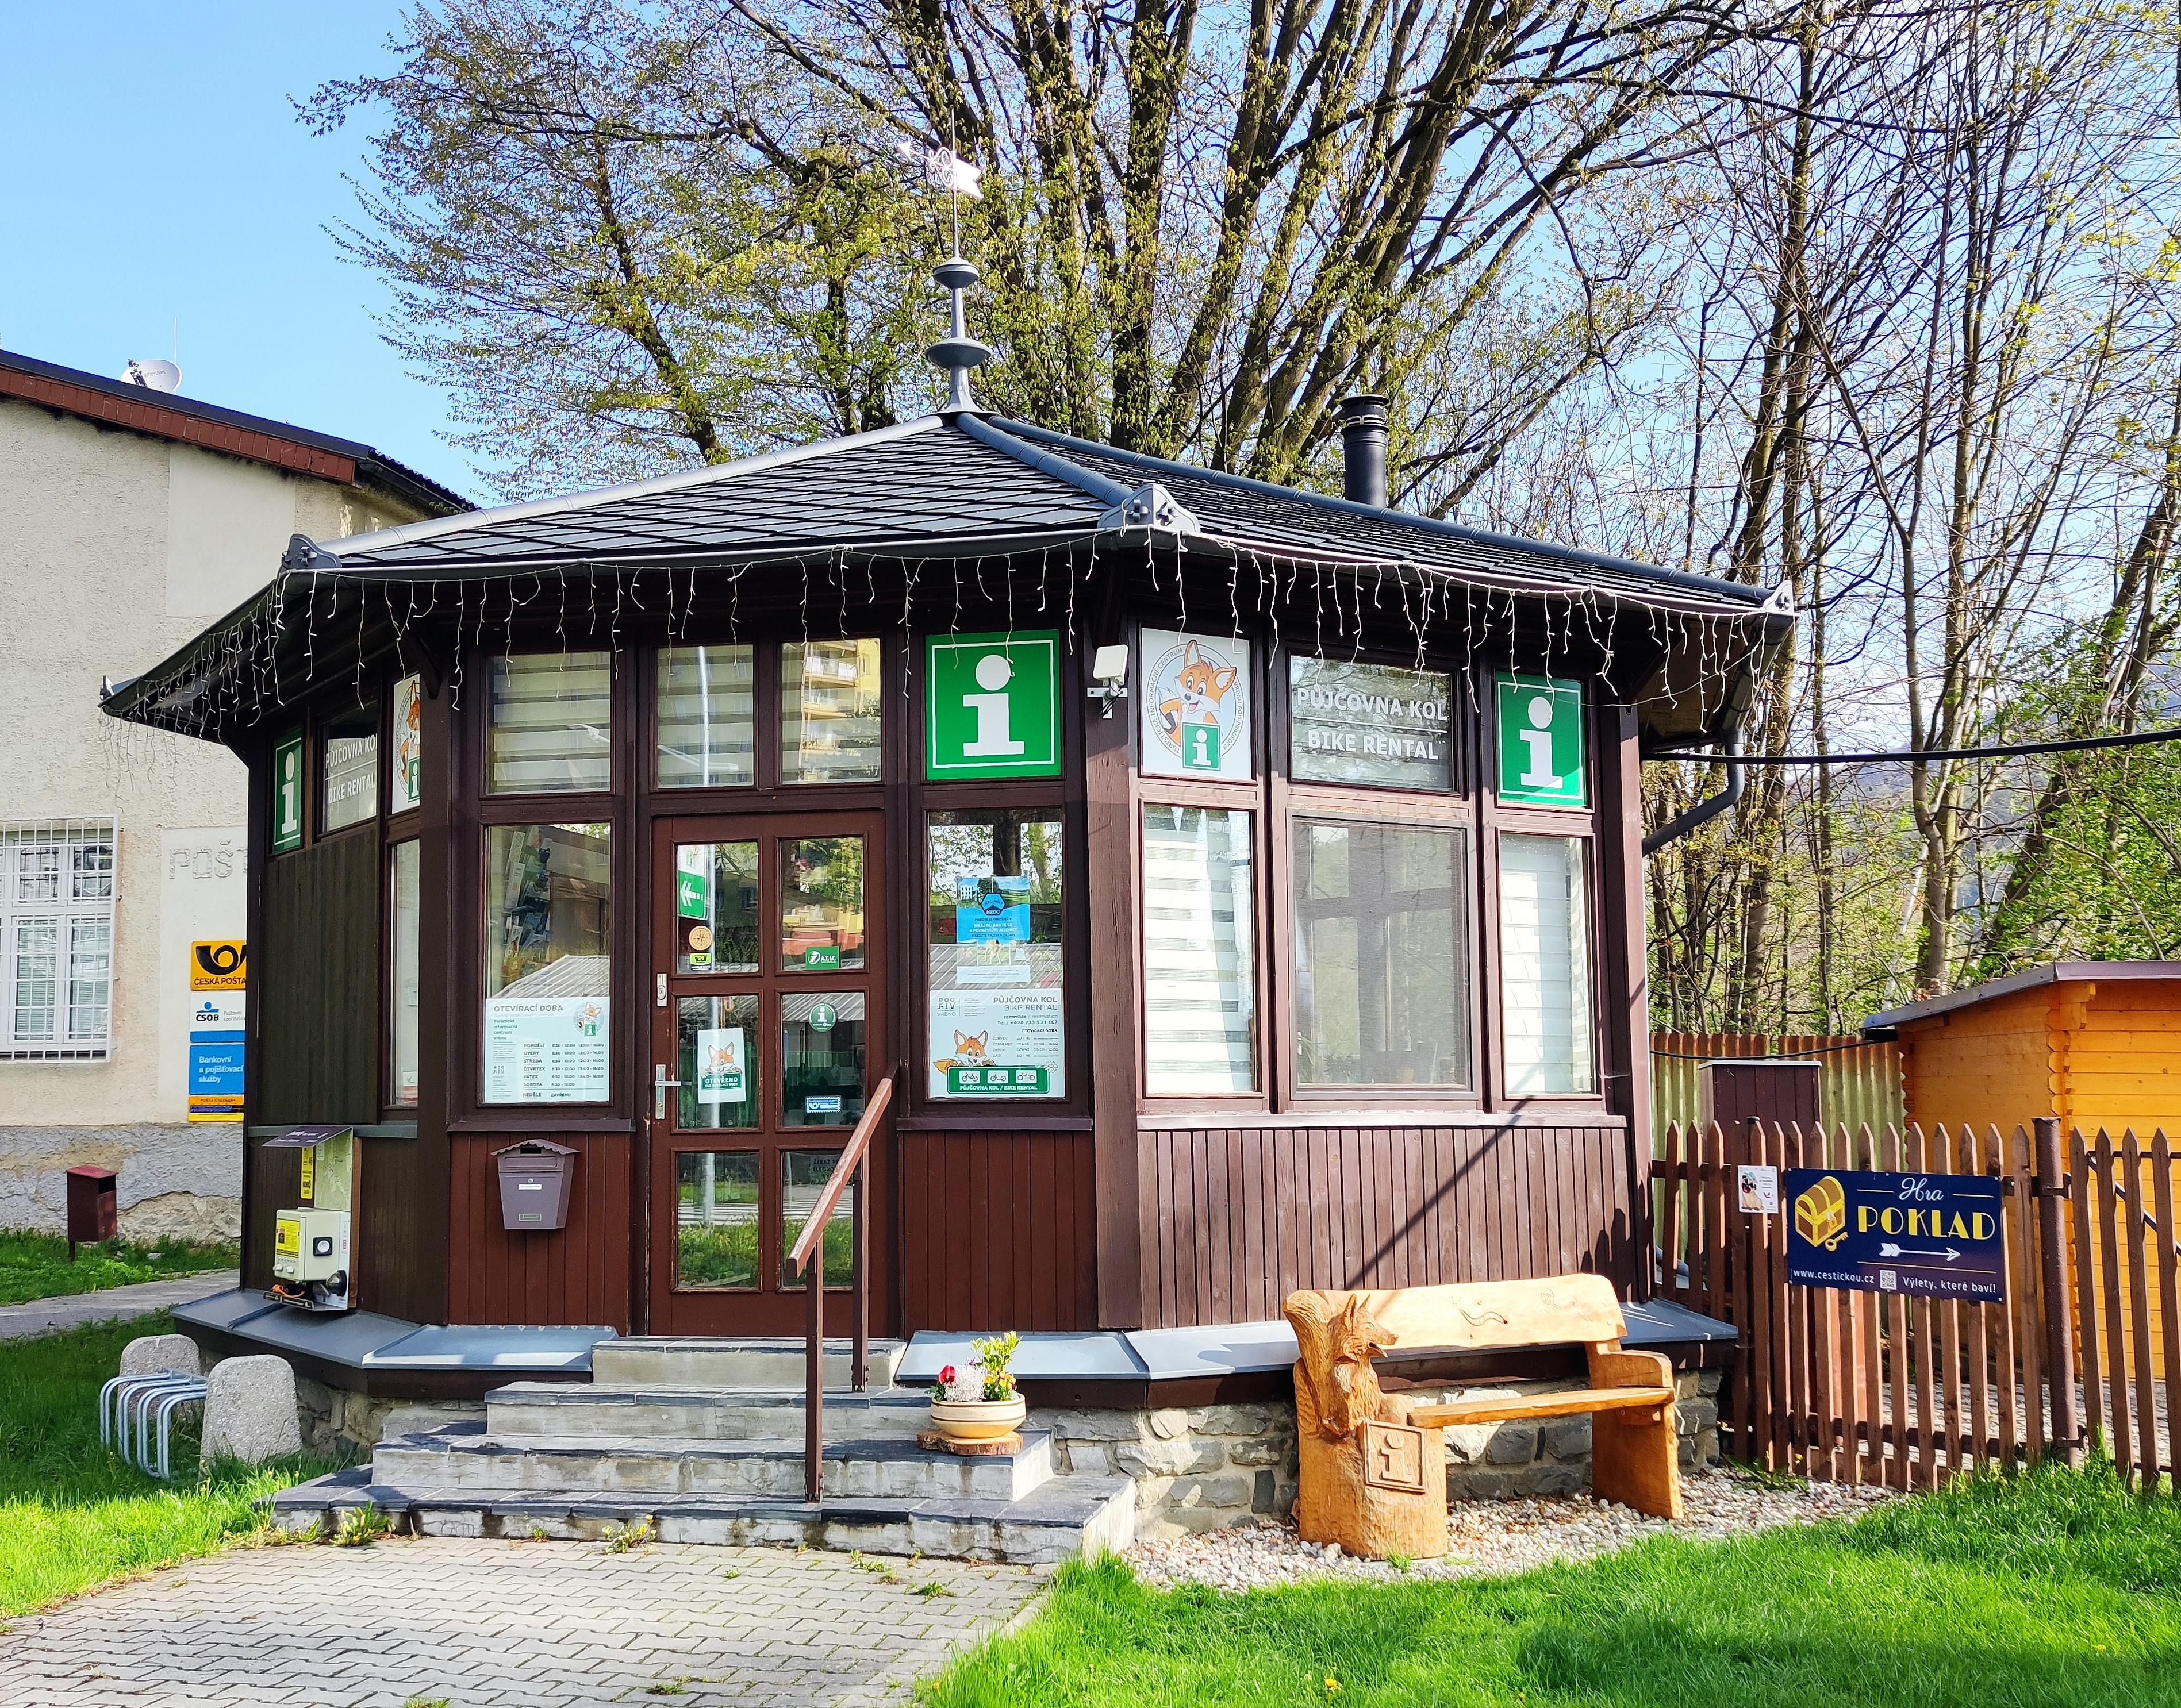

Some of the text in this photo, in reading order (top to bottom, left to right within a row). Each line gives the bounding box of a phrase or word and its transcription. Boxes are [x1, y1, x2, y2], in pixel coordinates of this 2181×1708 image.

[1158, 648, 1183, 668] CENTRUM
[1234, 682, 1242, 703] VRBNO
[1410, 700, 1447, 721] KOL
[326, 740, 363, 769] PŮJČOVNA
[1308, 730, 1438, 760] BIKE RENTAL
[328, 772, 375, 803] BIKE RENTAL
[194, 976, 246, 985] ČESKÁ POŠTA
[494, 1003, 537, 1012] OTEVÍRACÍ
[993, 995, 1038, 1003] PŮJČOVNA
[199, 1075, 221, 1083] služby
[205, 1065, 244, 1074] pojišťovací
[1899, 1178, 1945, 1201] Hra
[1857, 1206, 1995, 1240] POKLAD
[1794, 1270, 1996, 1294] www.cestickou.cz Výlety, které baví!
